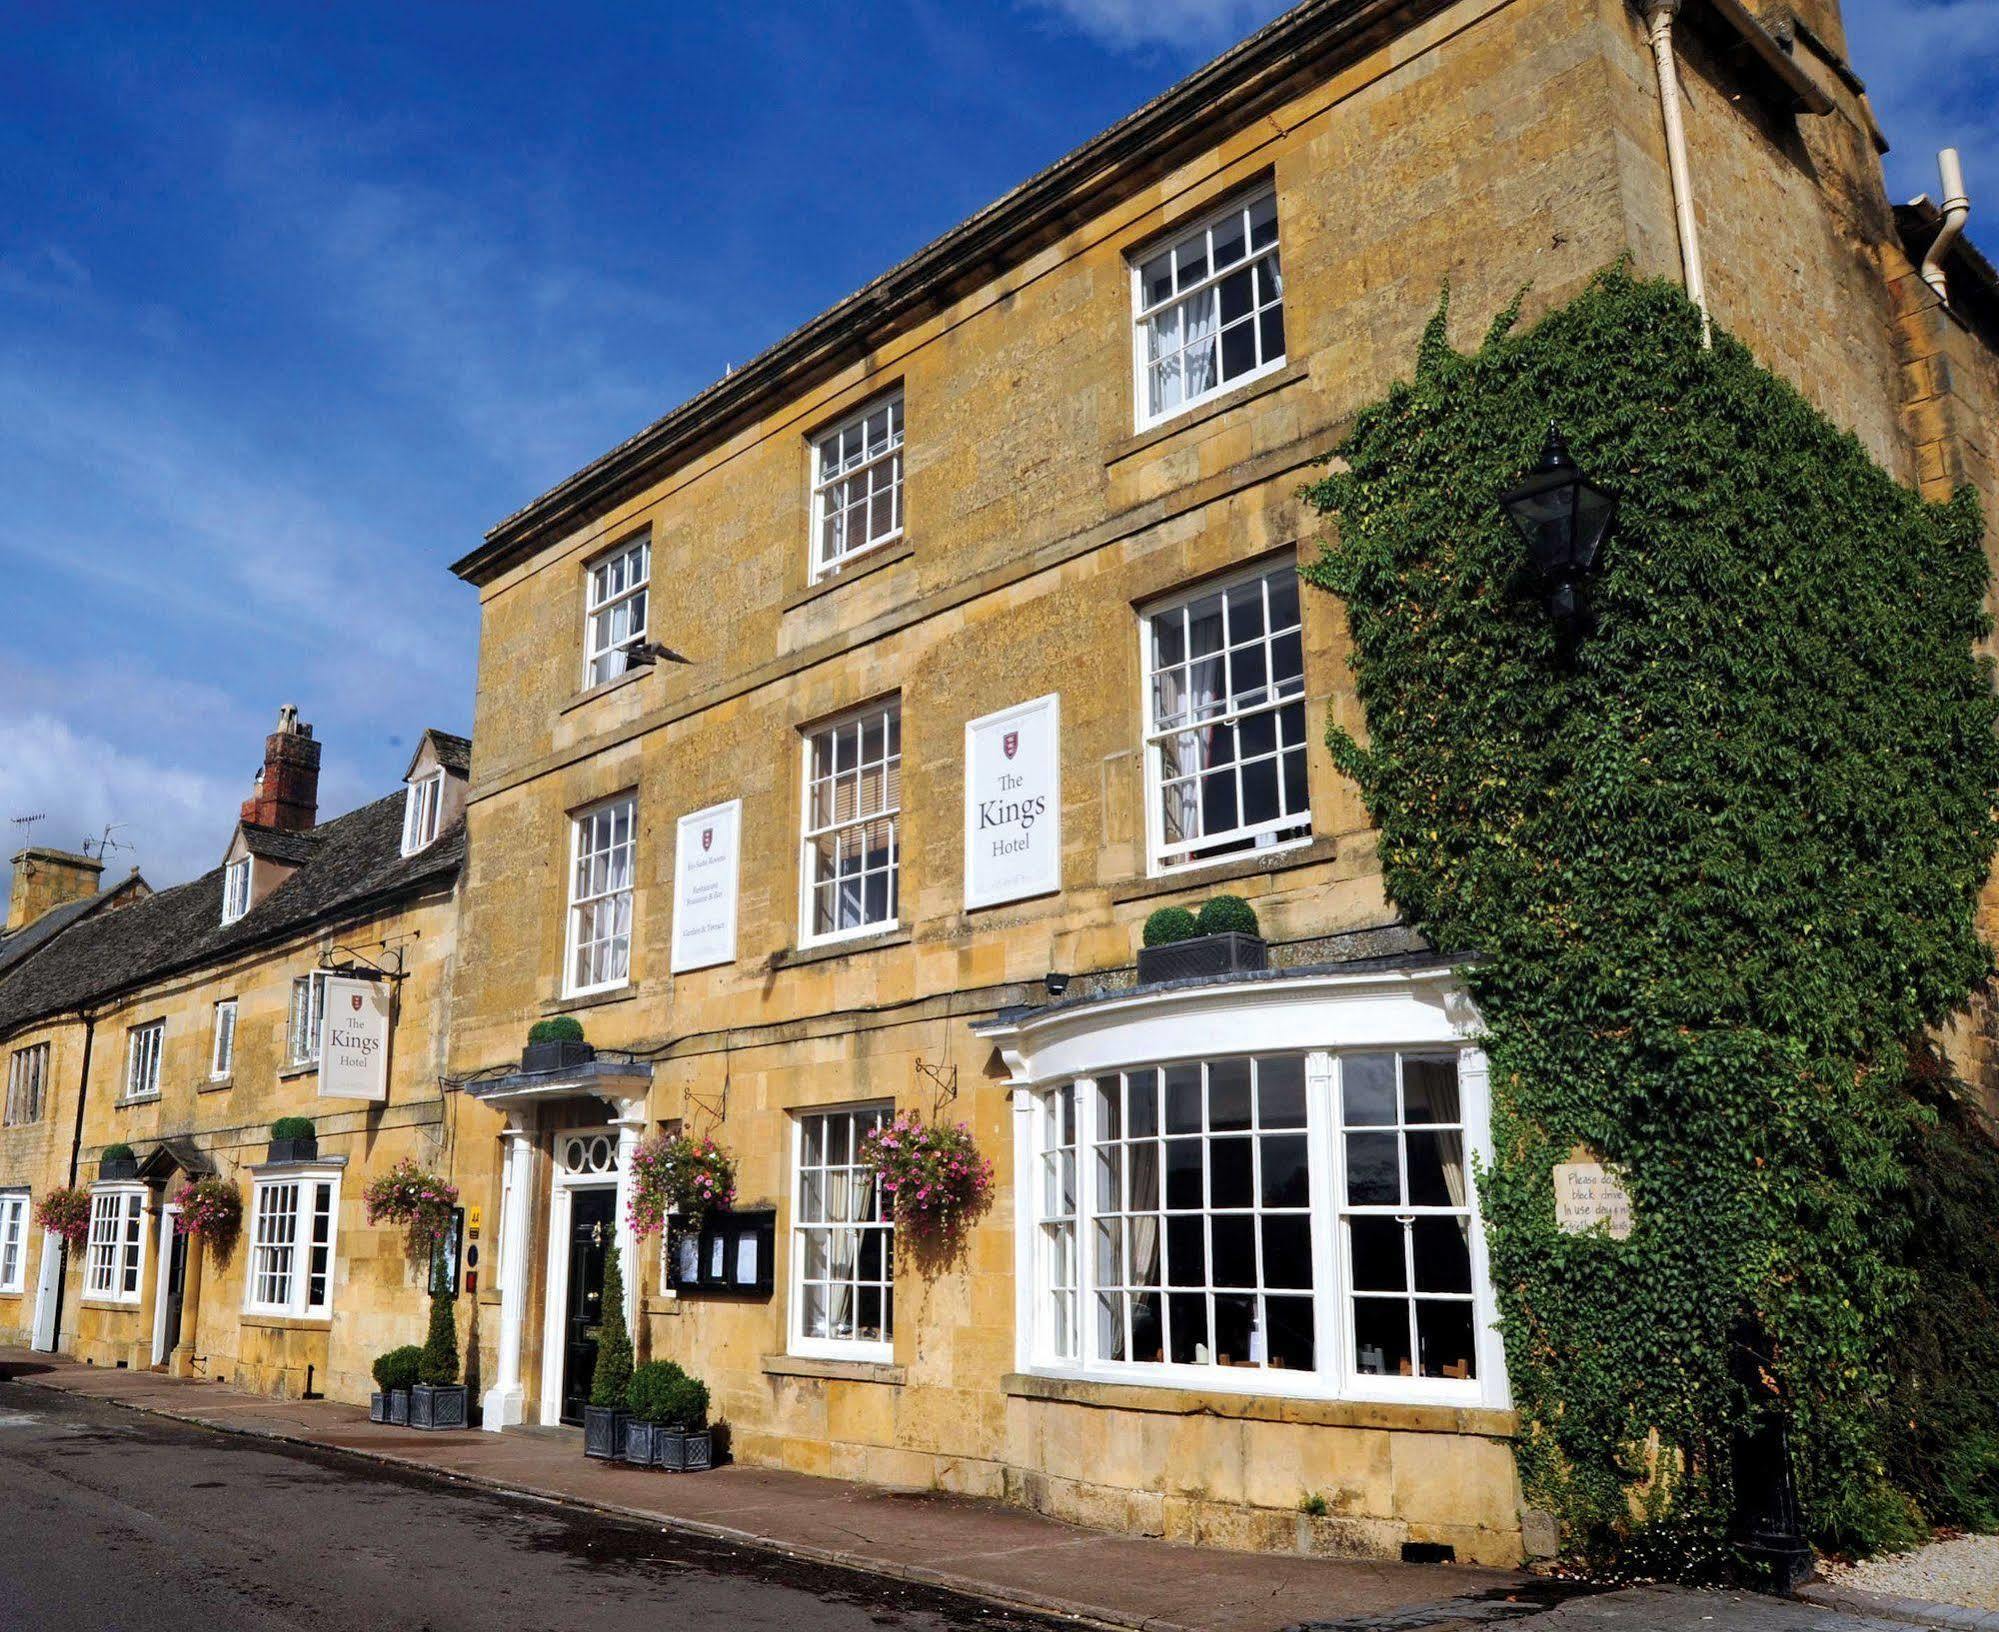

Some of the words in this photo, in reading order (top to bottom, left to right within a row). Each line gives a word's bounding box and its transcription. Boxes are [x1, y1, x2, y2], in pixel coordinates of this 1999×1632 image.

[998, 773, 1024, 792] The
[978, 795, 1046, 830] Kings
[992, 832, 1030, 858] Hotel
[346, 1017, 365, 1029] The
[330, 1029, 379, 1055] Kings
[340, 1056, 367, 1068] Hotel
[1568, 1173, 1597, 1185] Please
[1572, 1188, 1594, 1200] block
[1601, 1188, 1623, 1200] drive
[1574, 1205, 1590, 1215] use
